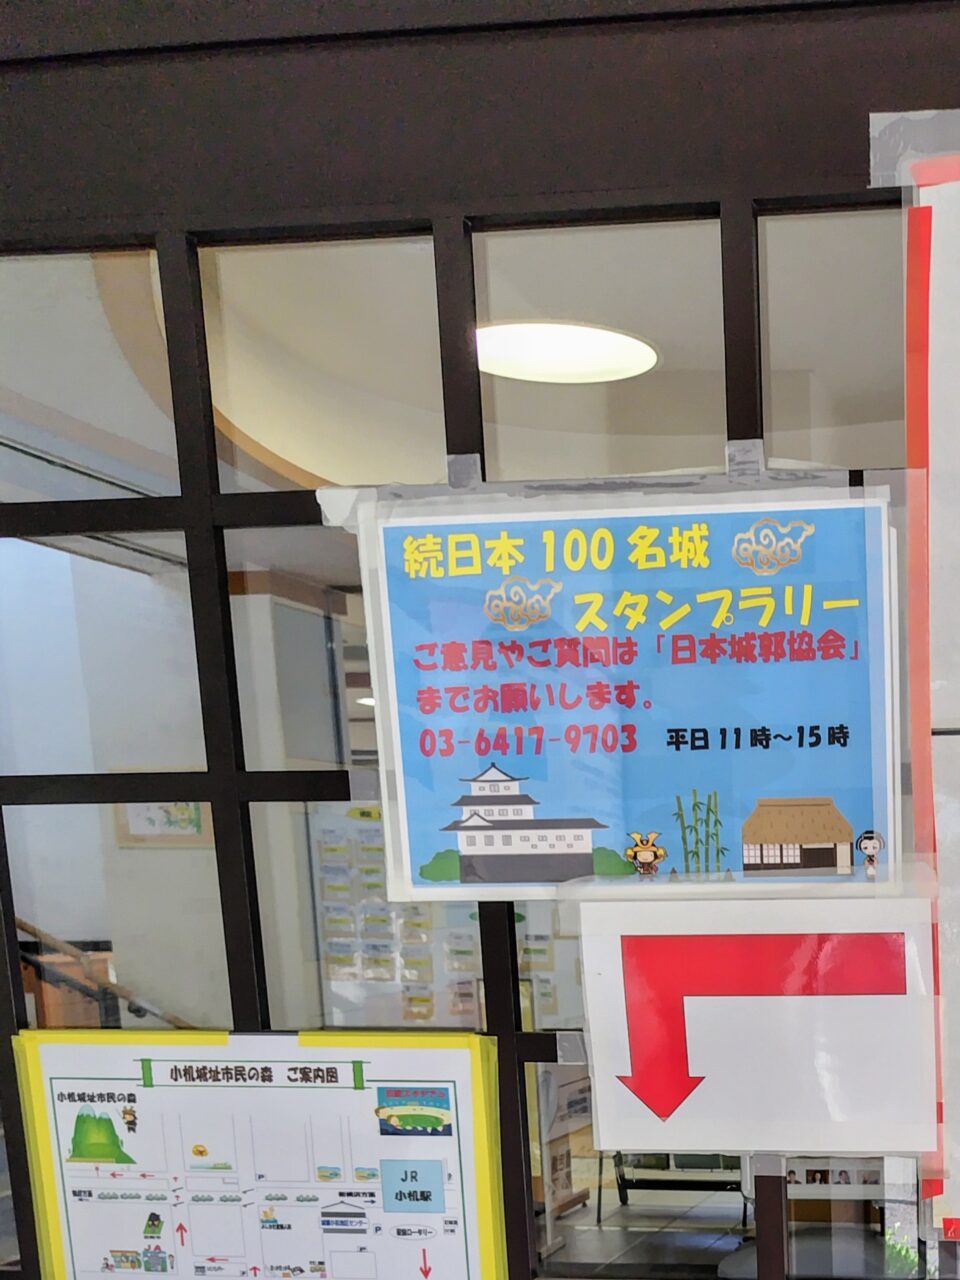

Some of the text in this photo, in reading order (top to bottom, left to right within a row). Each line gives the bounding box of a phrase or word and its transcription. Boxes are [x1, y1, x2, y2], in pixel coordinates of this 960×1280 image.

[573, 584, 861, 631] スタンプラリー
[416, 680, 654, 714] までお願いします。
[418, 723, 638, 757] 03-6417-9703
[170, 1065, 338, 1083] 小机城址市民の森 ご案内図
[57, 1092, 137, 1104] 小机城址市民の森
[400, 1170, 418, 1182] JR
[394, 1190, 433, 1202] 小机駅
